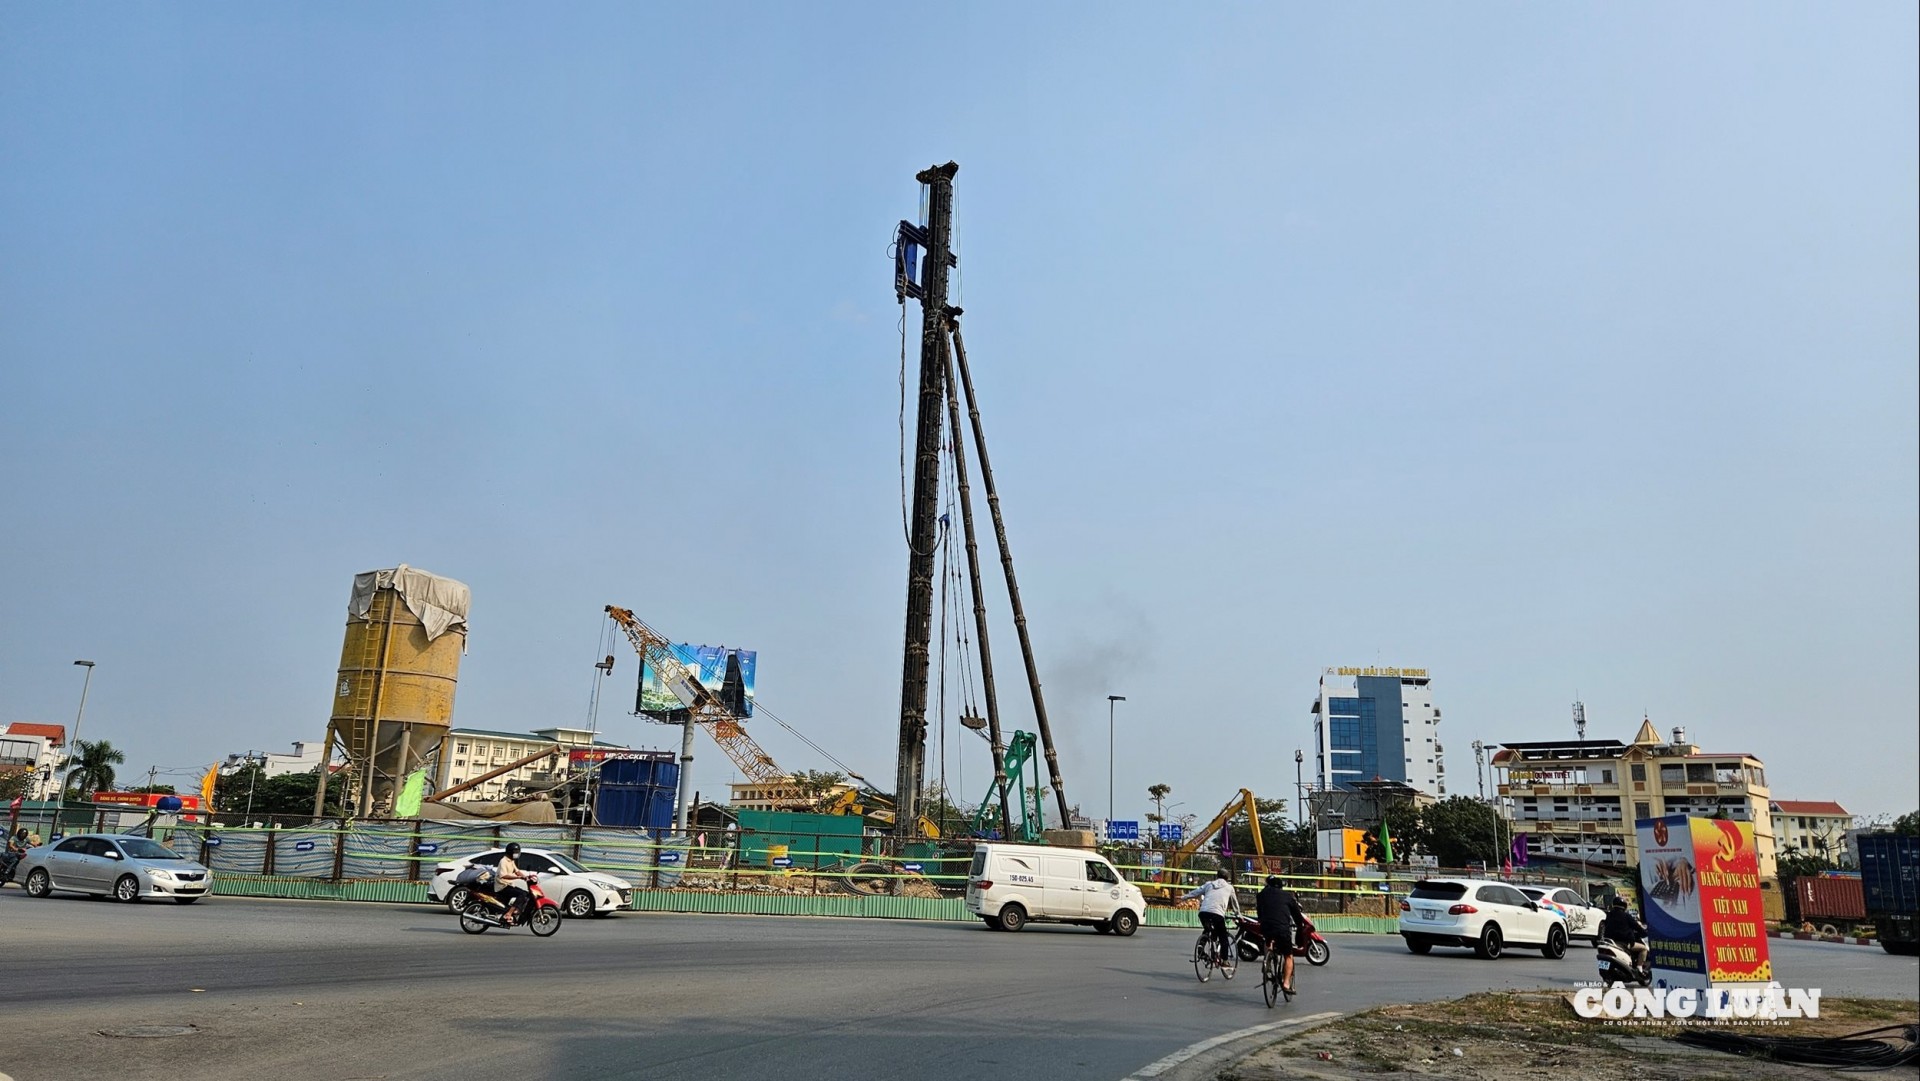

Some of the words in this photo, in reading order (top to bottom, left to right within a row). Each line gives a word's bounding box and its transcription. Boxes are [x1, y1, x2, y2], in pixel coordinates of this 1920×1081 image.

[1701, 865, 1720, 887] ĐẢNG
[1722, 869, 1740, 891] CỘNG
[1742, 867, 1757, 888] SẢN
[1713, 896, 1730, 918] VIỆT
[1732, 899, 1748, 915] NAM
[1712, 922, 1736, 937] QUANG
[1738, 922, 1757, 937] VINH
[1716, 944, 1737, 962] MUÔN
[1739, 944, 1757, 962] NĂM!
